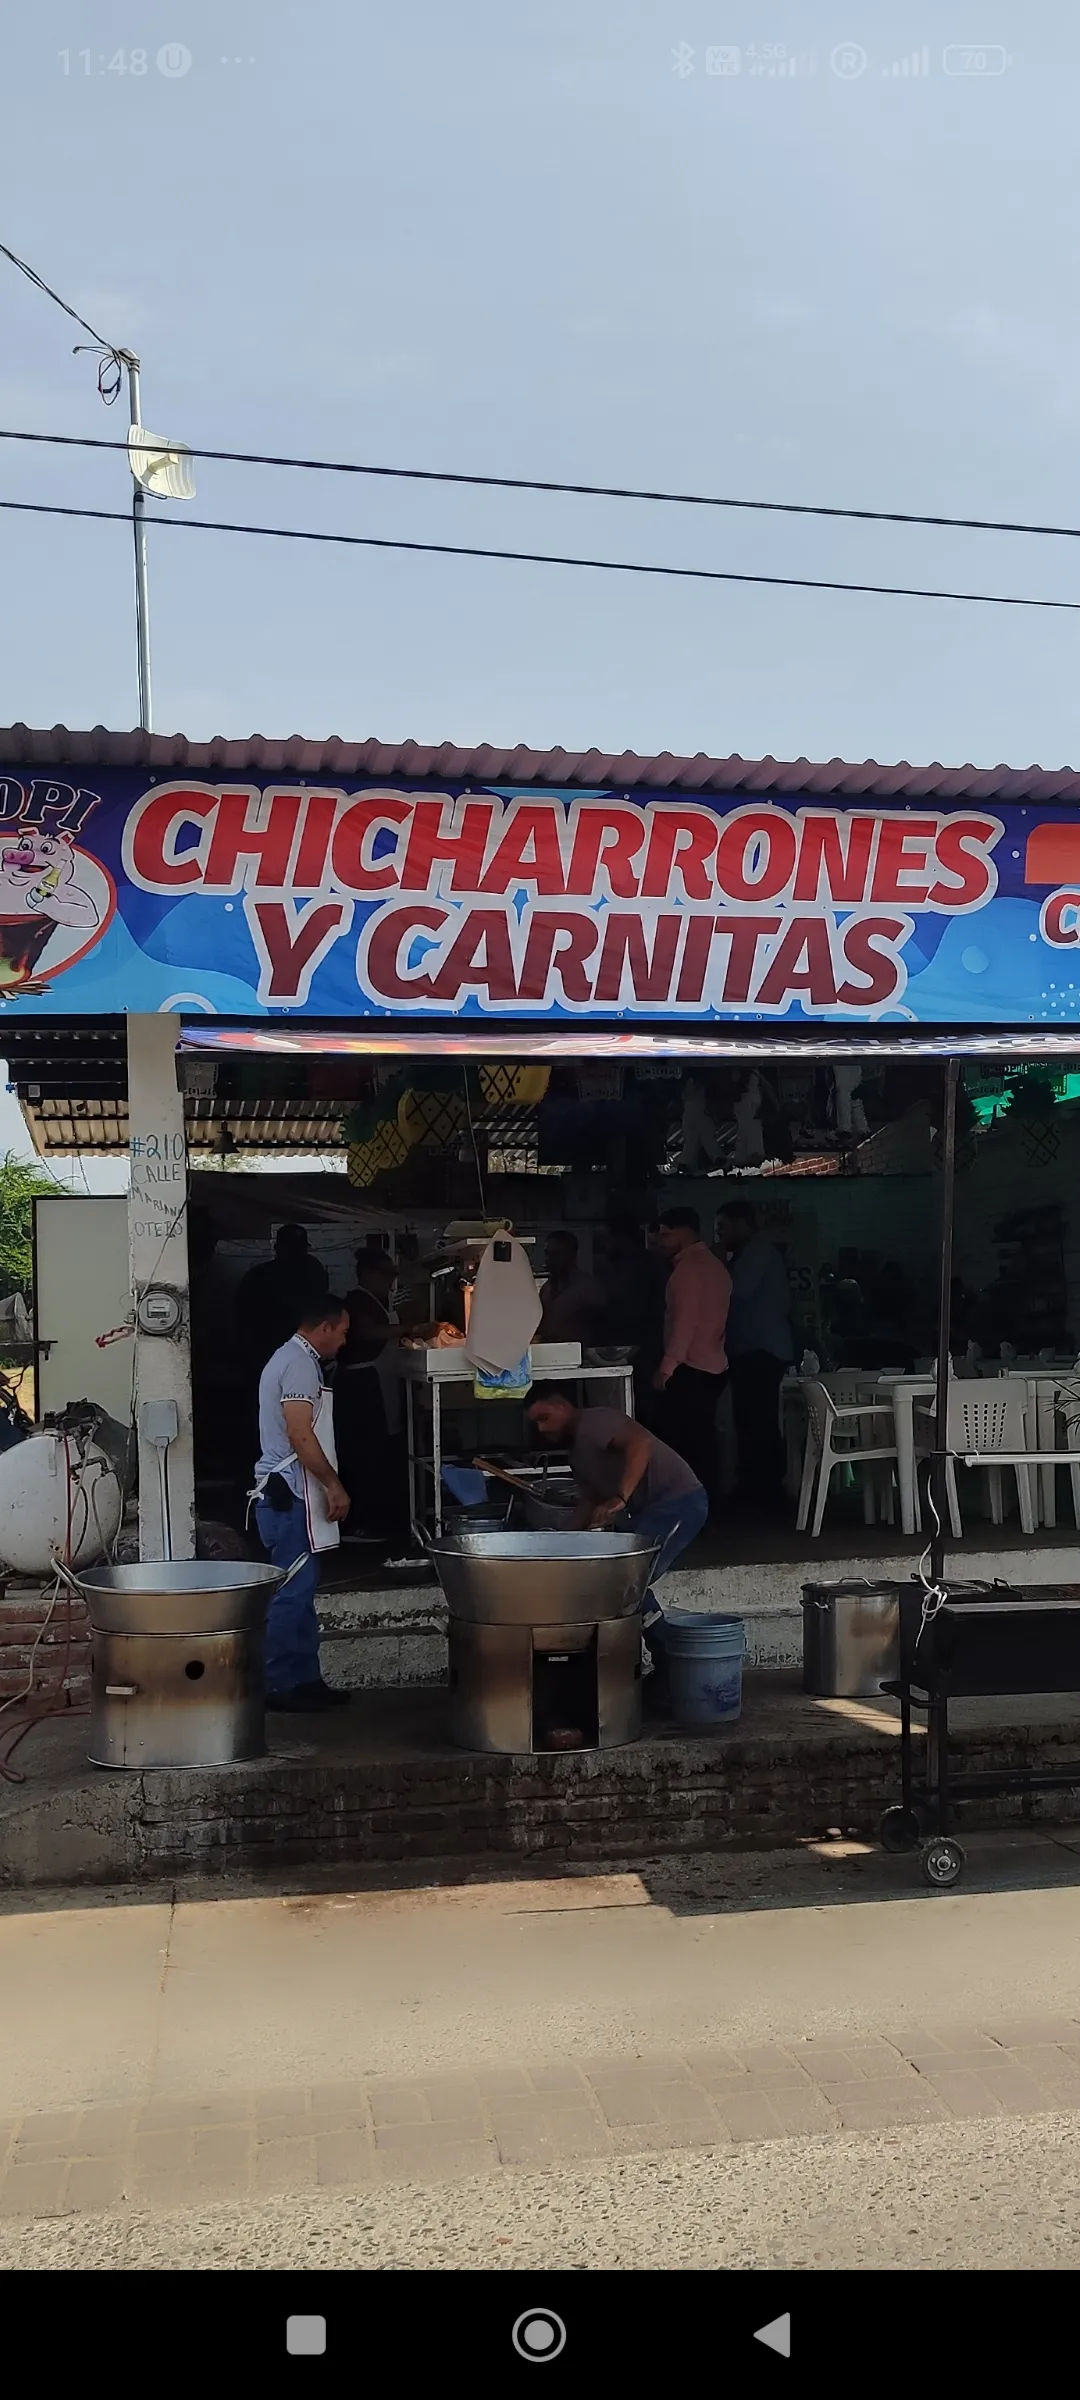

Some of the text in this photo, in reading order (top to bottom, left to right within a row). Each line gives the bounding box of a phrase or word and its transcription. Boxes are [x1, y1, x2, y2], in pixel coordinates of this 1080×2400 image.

[131, 789, 996, 907] CHICHARRONES
[254, 902, 907, 1006] Y CARNITAS
[130, 1133, 184, 1160] #210
[133, 1164, 182, 1184] CALLE
